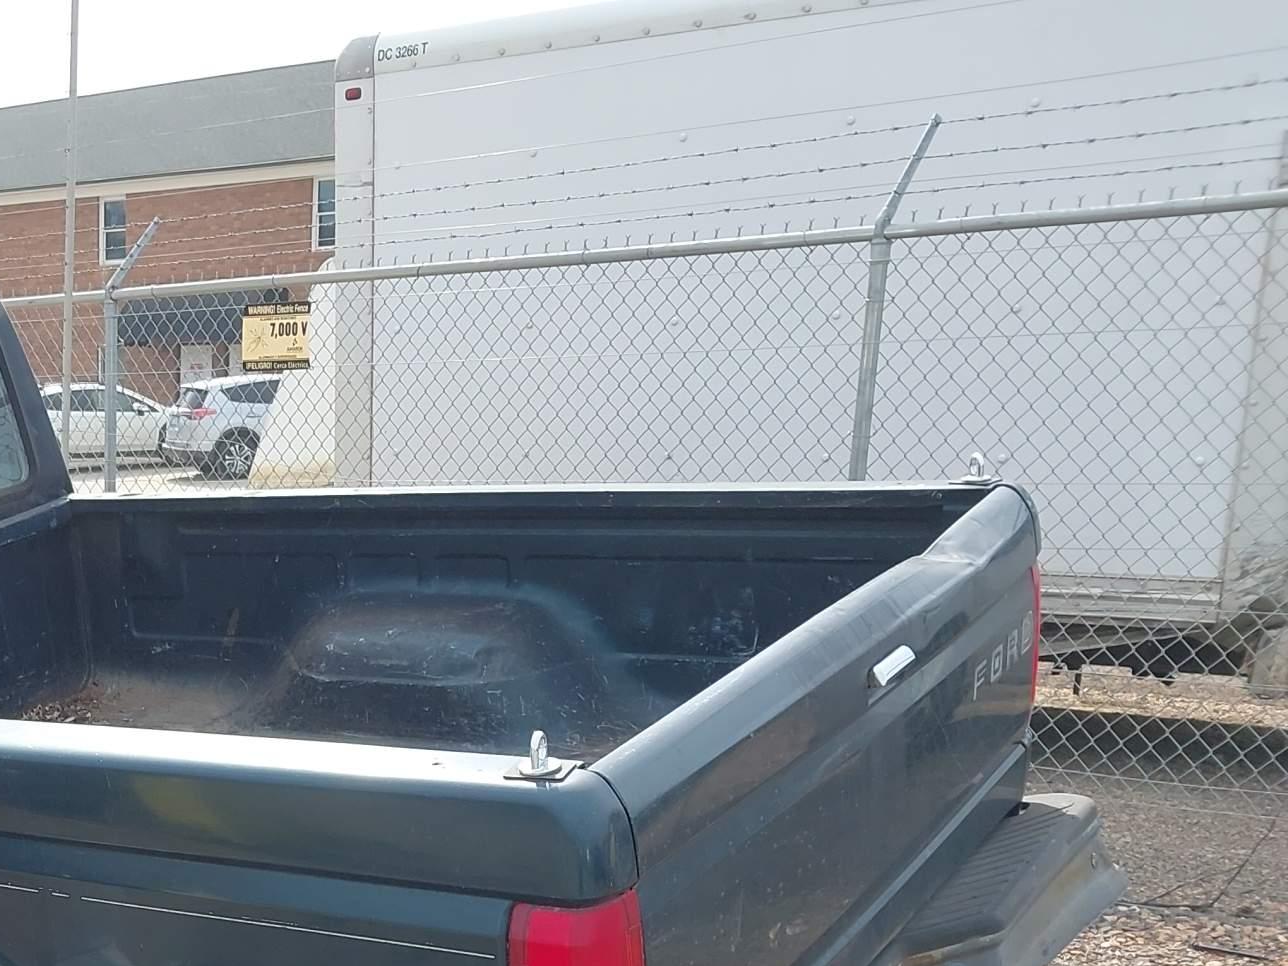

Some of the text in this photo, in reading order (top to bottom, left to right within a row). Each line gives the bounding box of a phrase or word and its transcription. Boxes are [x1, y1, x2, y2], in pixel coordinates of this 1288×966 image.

[377, 41, 429, 61] DC 3266 T
[247, 303, 309, 315] WARNING! Electric Fence
[270, 320, 308, 339] 7,000 V
[973, 610, 1033, 701] FORD
